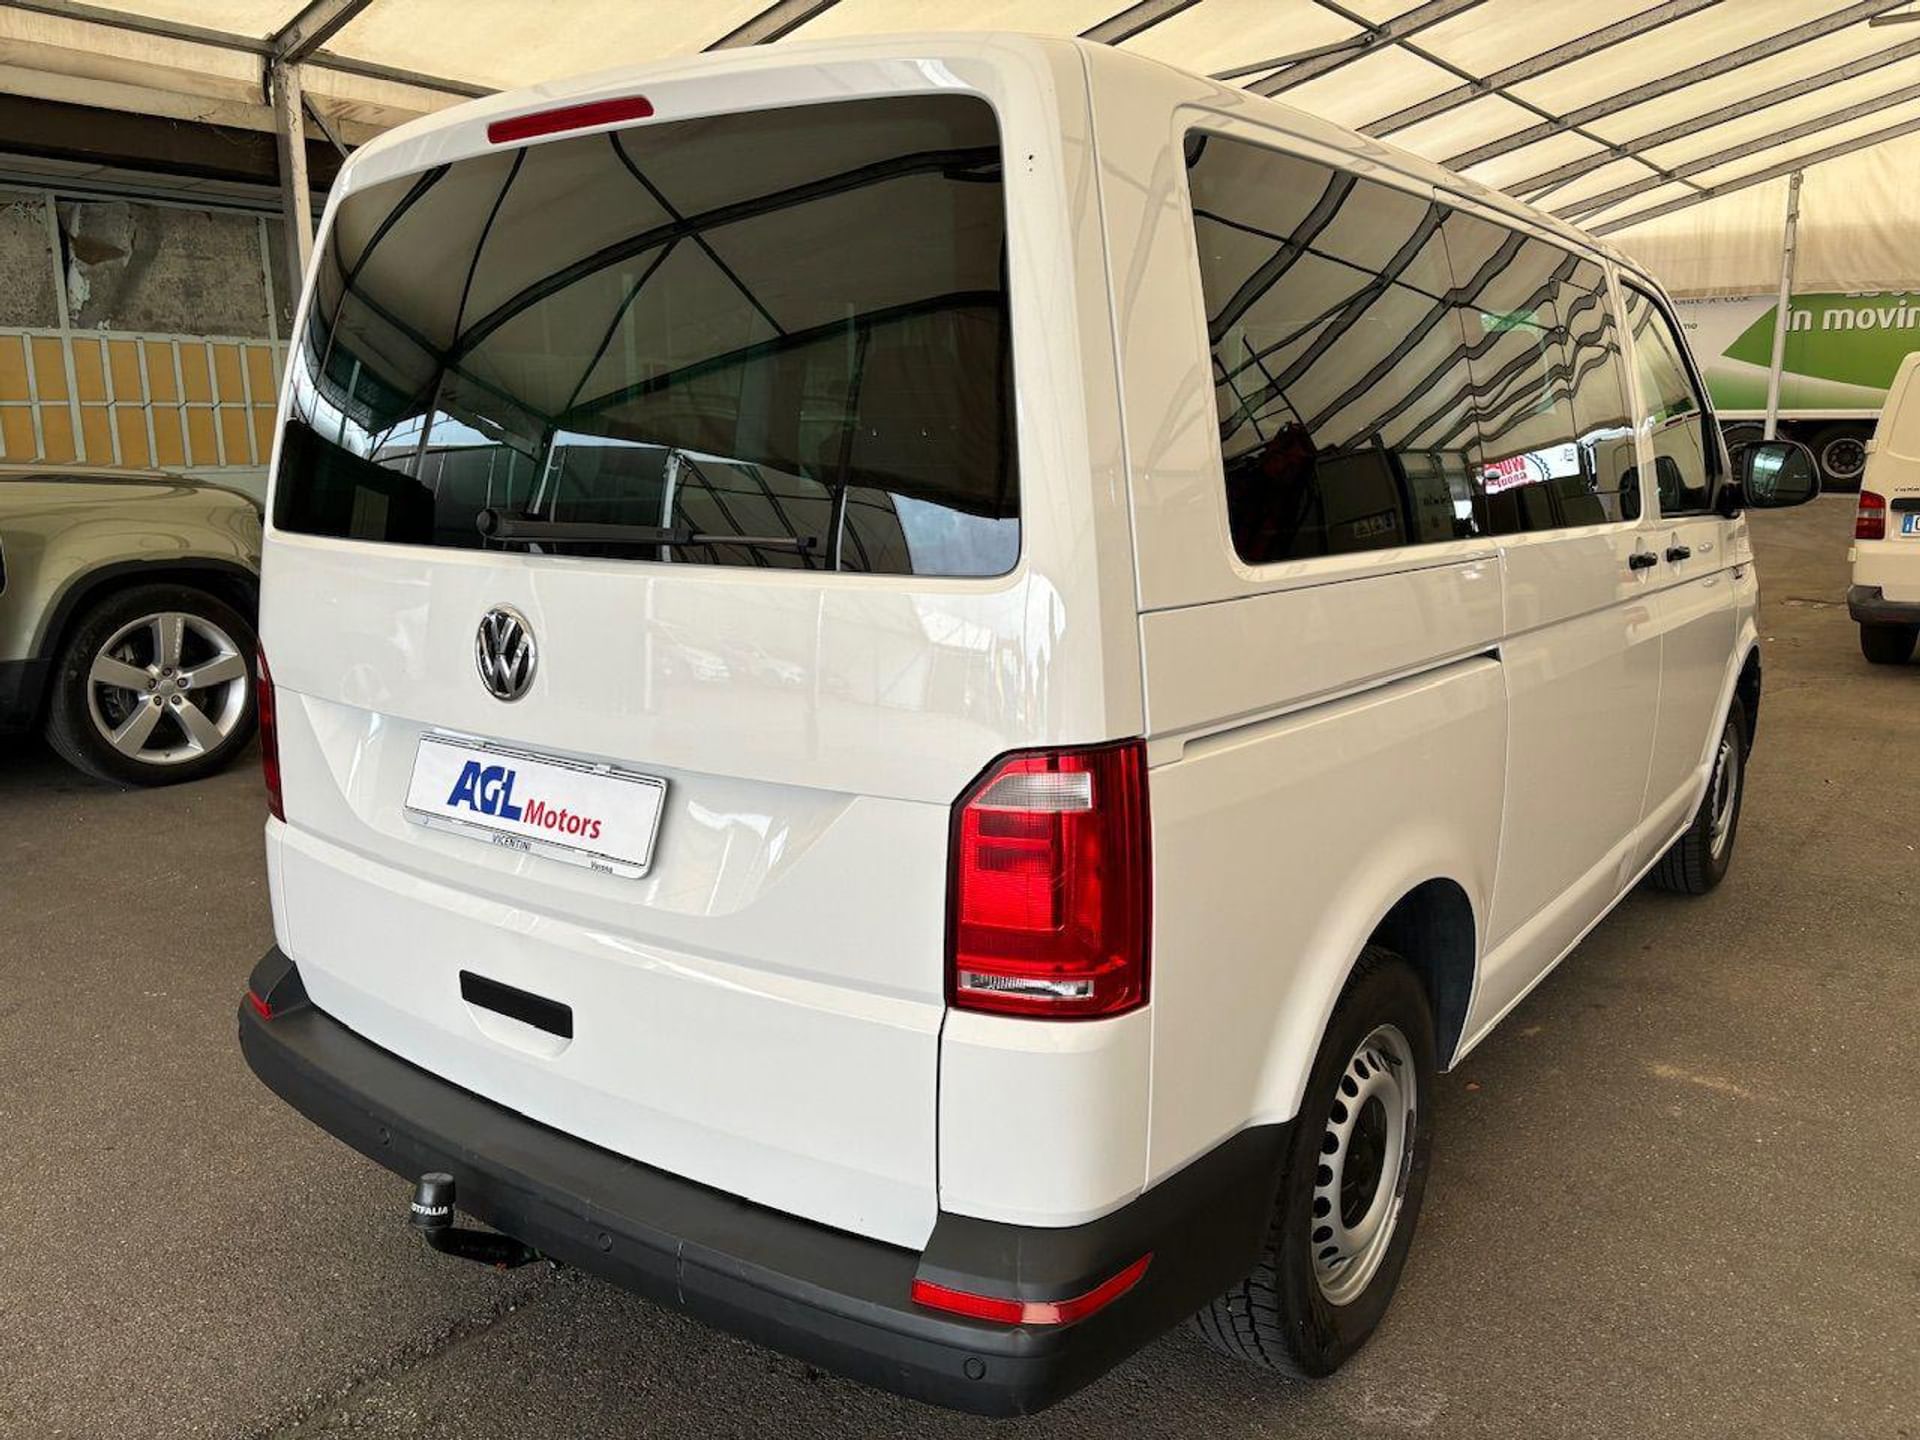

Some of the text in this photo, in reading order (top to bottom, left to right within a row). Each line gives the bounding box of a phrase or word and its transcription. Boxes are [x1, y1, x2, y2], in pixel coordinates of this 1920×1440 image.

[1785, 303, 1813, 331] in
[447, 760, 602, 840] AGL Motors
